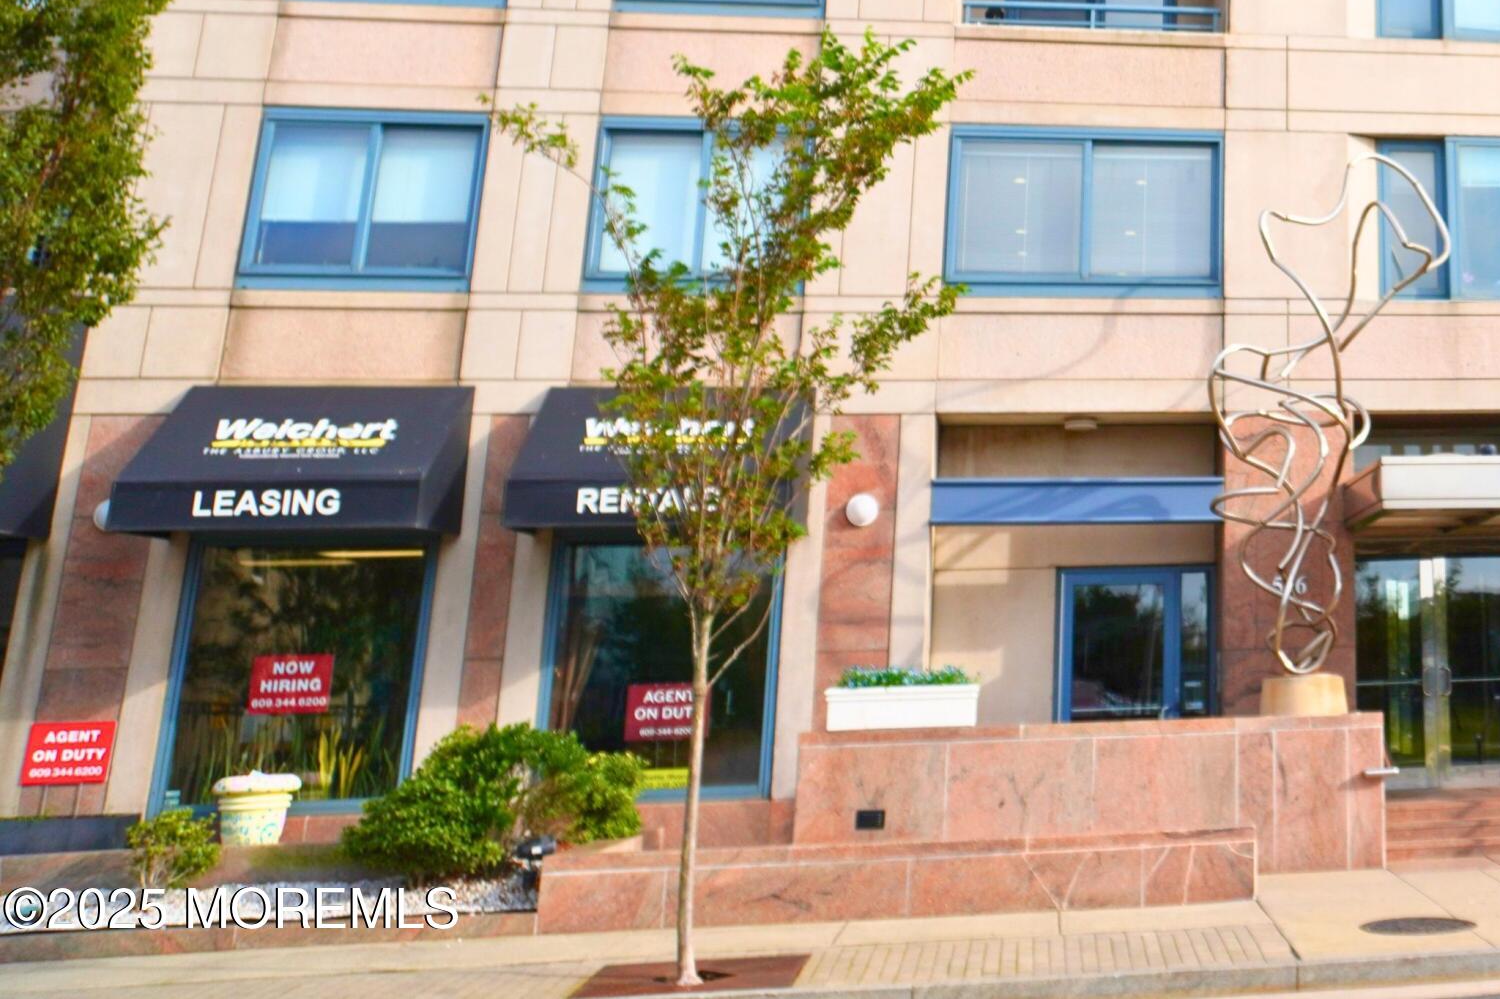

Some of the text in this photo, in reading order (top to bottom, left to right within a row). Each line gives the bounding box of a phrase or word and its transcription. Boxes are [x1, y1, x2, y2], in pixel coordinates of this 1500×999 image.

[215, 418, 398, 440] Weichert
[192, 488, 341, 517] LEASING
[1272, 575, 1307, 596] 56
[273, 661, 315, 675] NOW
[260, 678, 322, 693] HIRING
[634, 706, 658, 721] ON
[44, 730, 101, 744] AGENT
[32, 747, 106, 763] ON DUTY
